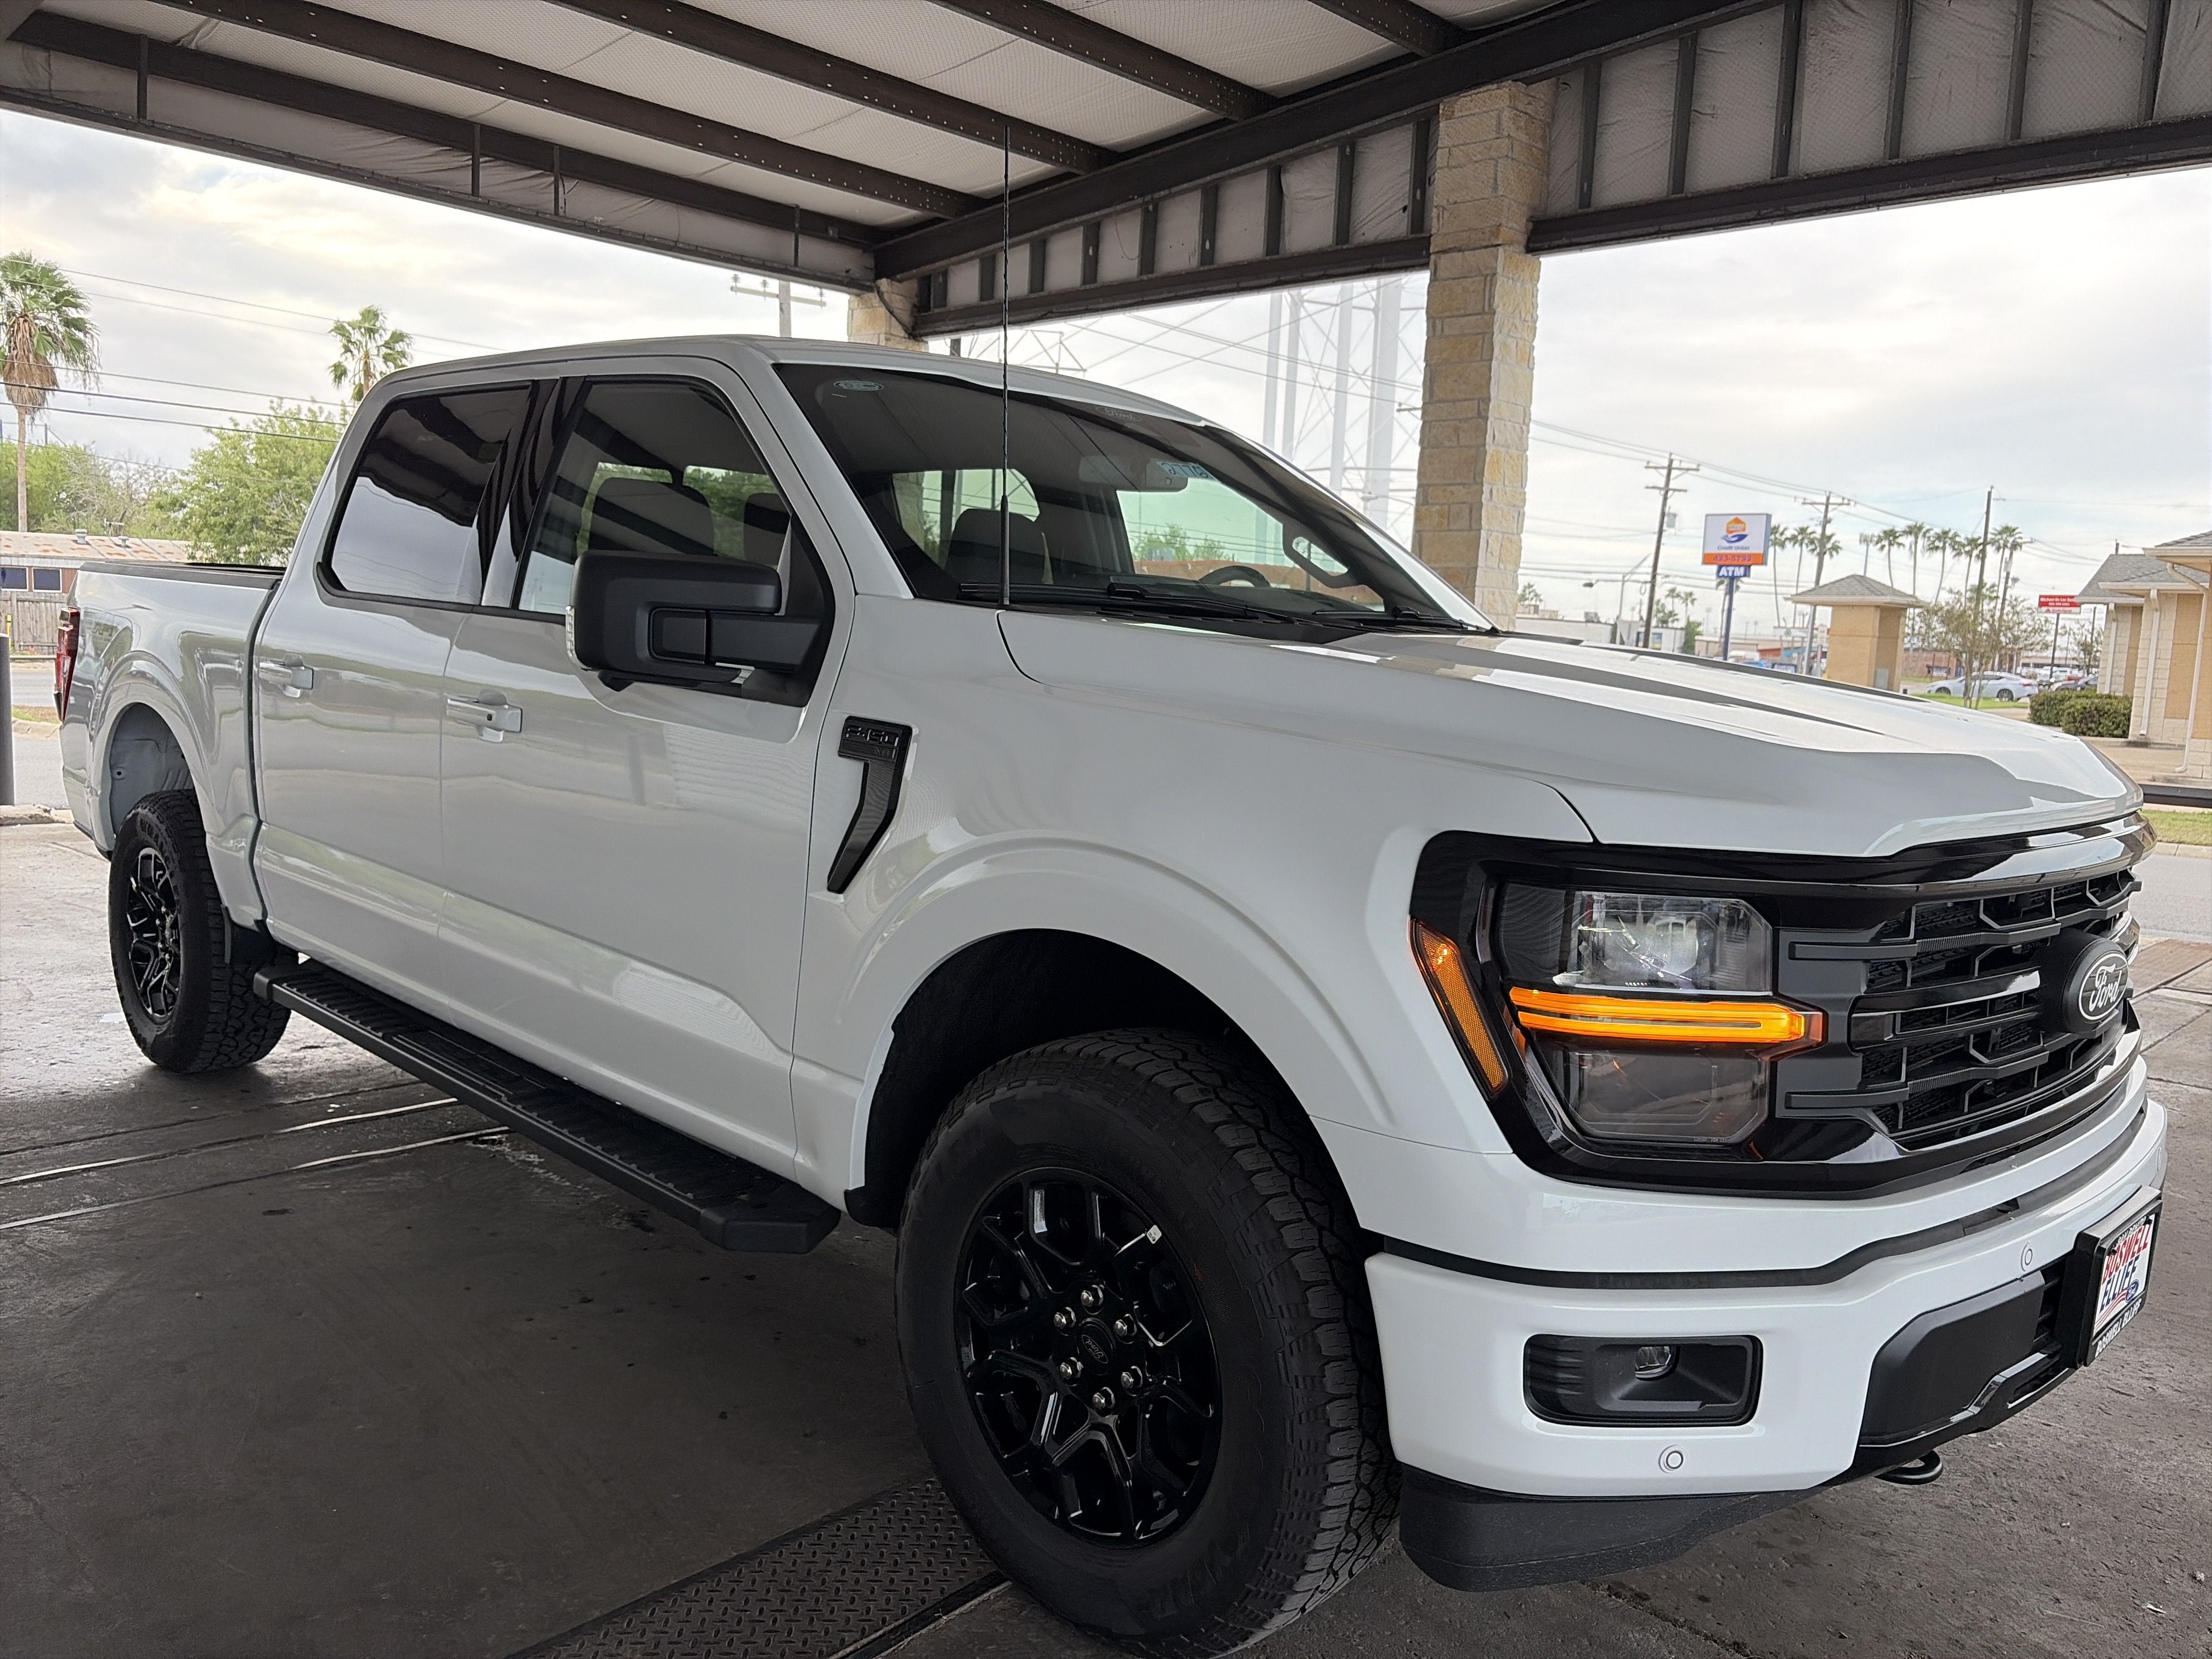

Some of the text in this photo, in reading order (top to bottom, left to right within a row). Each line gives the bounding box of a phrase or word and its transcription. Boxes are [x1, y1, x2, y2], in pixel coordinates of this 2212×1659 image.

[1719, 566, 1745, 577] ATM
[2089, 963, 2123, 1012] Ford
[2102, 1224, 2150, 1285] BOSWELL
[2100, 1255, 2140, 1313] ELLIFF
[1085, 1339, 1104, 1359] Ford
[2095, 1318, 2122, 1358] BOSWELL
